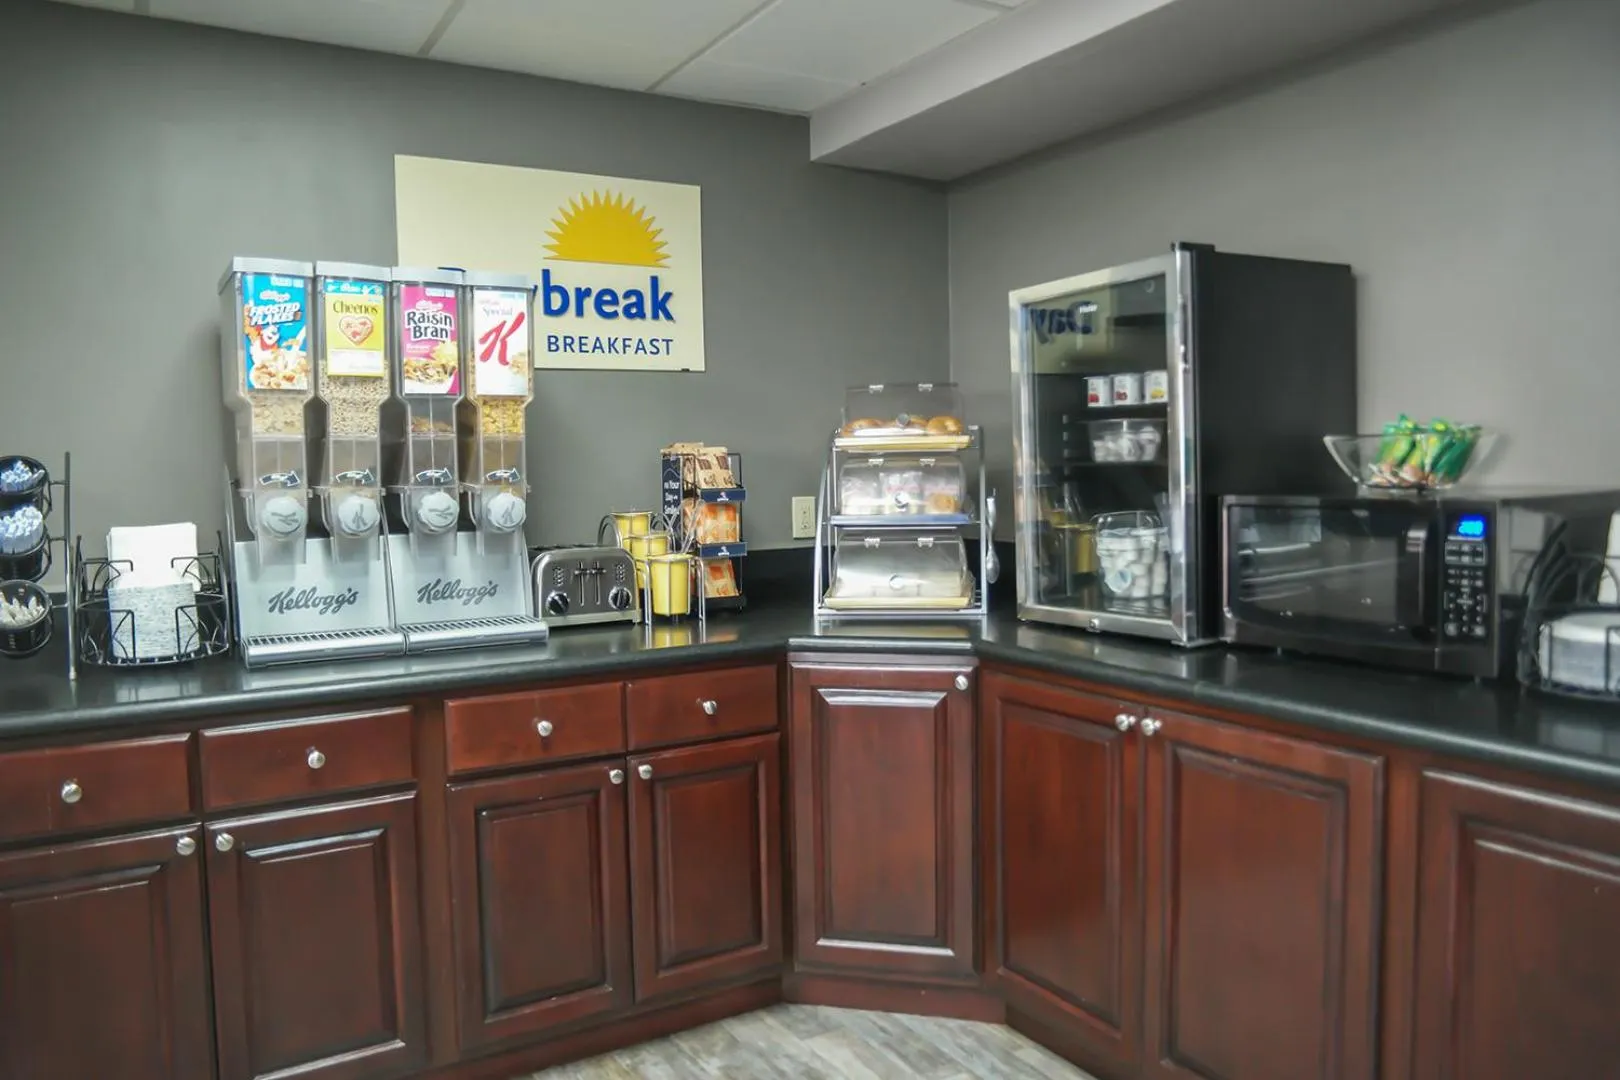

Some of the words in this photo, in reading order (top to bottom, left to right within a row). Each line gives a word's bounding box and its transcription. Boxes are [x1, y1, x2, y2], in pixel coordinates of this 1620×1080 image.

[249, 302, 301, 318] FROSTED
[332, 299, 378, 315] Cheerios
[482, 306, 513, 317] Special
[250, 311, 296, 326] FLAKES
[406, 311, 453, 327] Raisin
[412, 325, 449, 339] Bran
[478, 311, 526, 366] K
[547, 335, 674, 356] BREAKFAST
[417, 577, 499, 607] Kellogg's
[268, 586, 360, 616] Kellogg's
